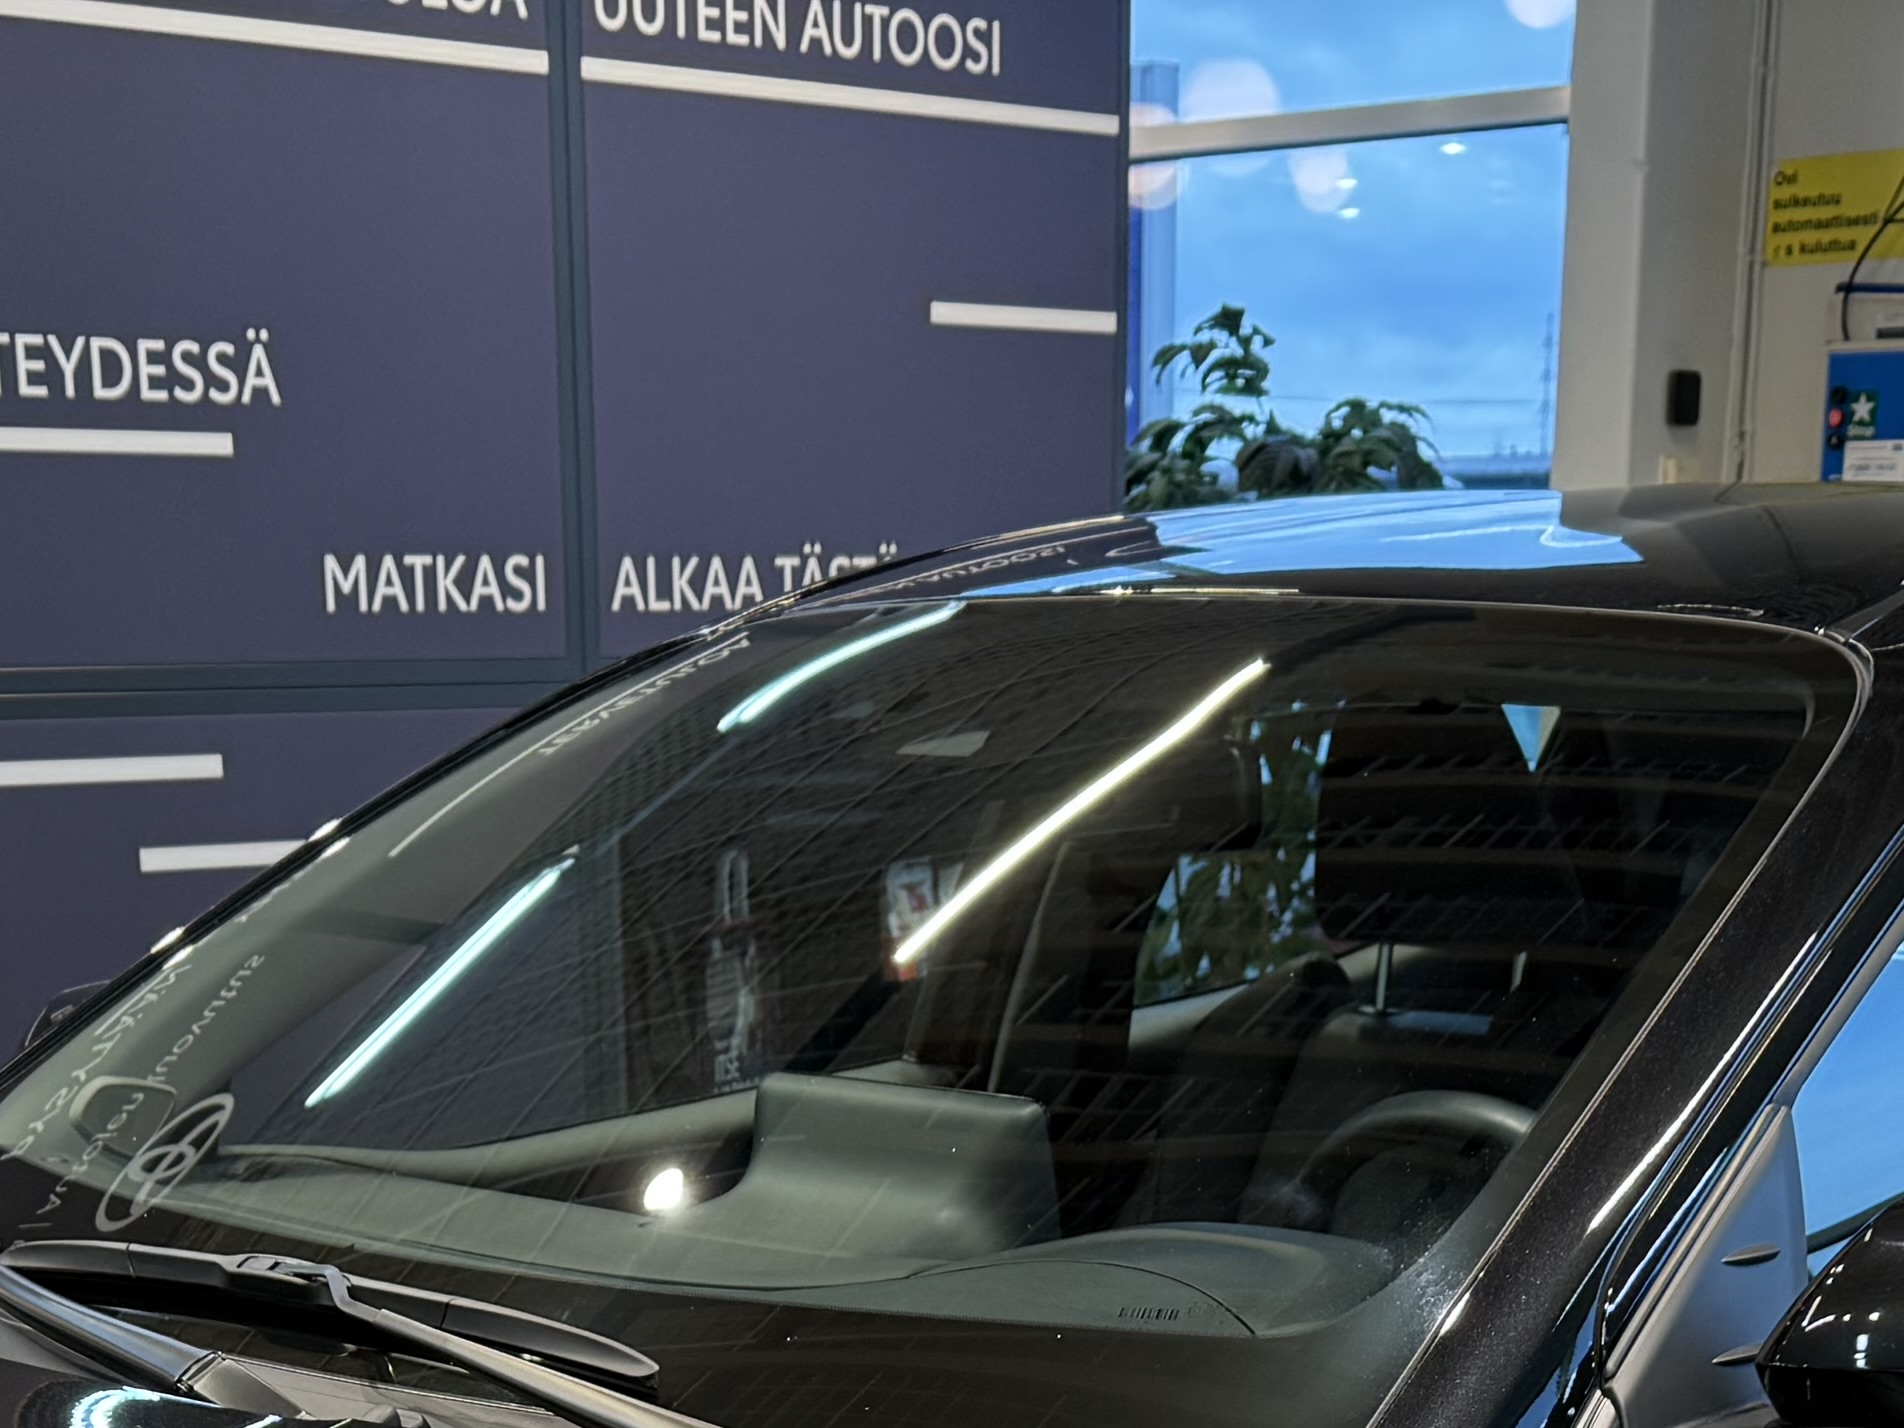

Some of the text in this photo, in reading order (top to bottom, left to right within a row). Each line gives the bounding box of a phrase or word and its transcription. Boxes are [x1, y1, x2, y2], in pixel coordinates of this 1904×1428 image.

[799, 0, 1001, 76] AUTOOSI
[323, 552, 546, 614] MATKASI
[610, 554, 764, 613] ALKAA
